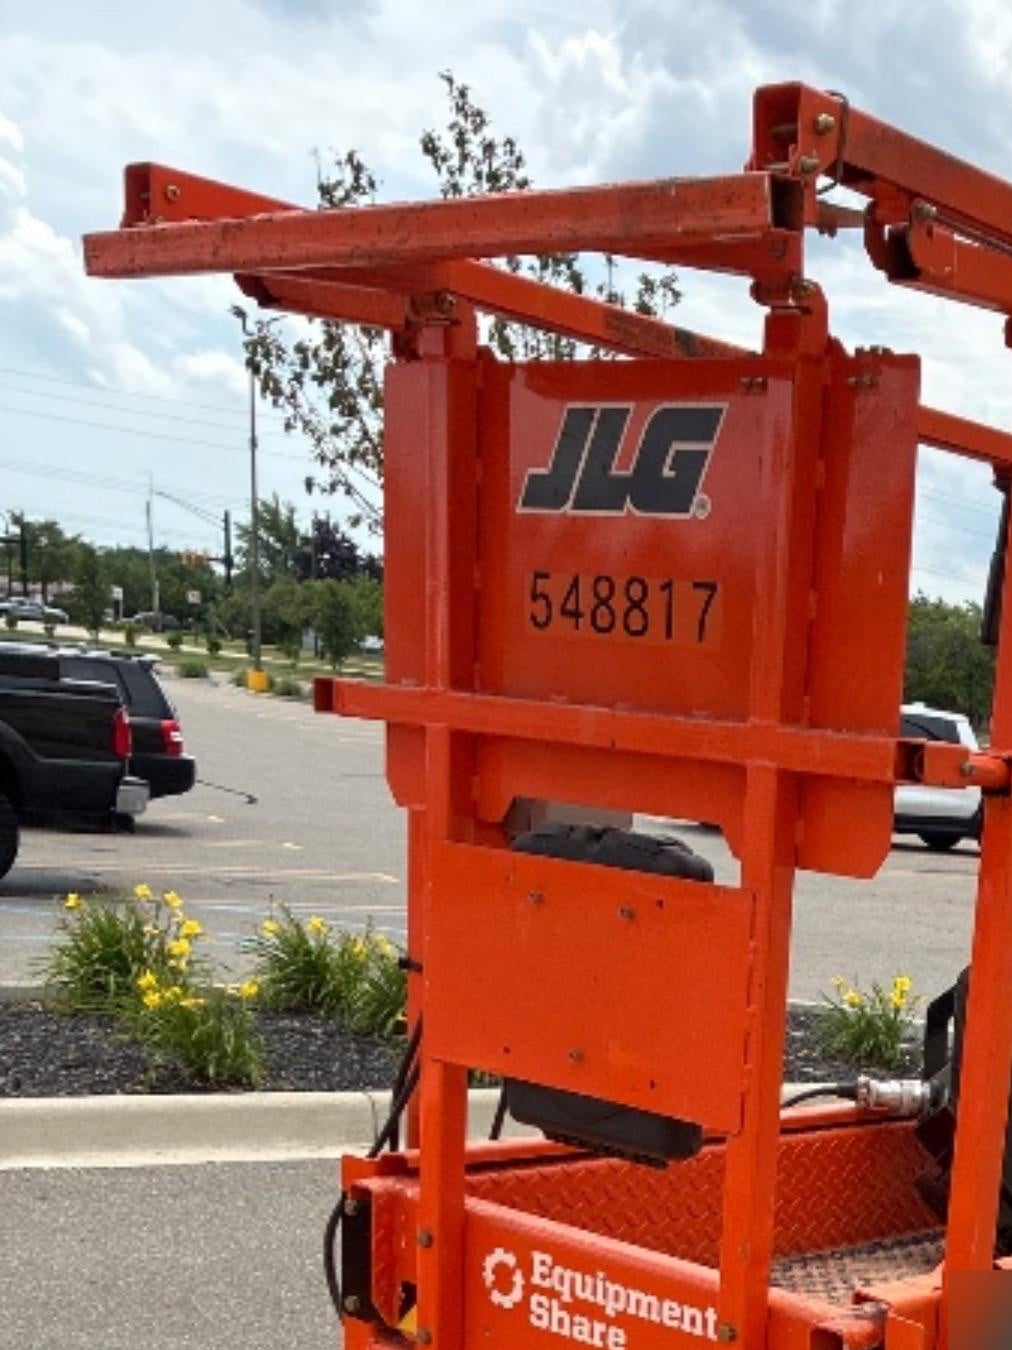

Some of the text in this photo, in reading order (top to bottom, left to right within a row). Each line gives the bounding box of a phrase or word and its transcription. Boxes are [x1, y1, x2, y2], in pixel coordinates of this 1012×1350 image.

[516, 402, 729, 519] JLG
[529, 570, 718, 643] 548817
[530, 1250, 718, 1341] Equipment
